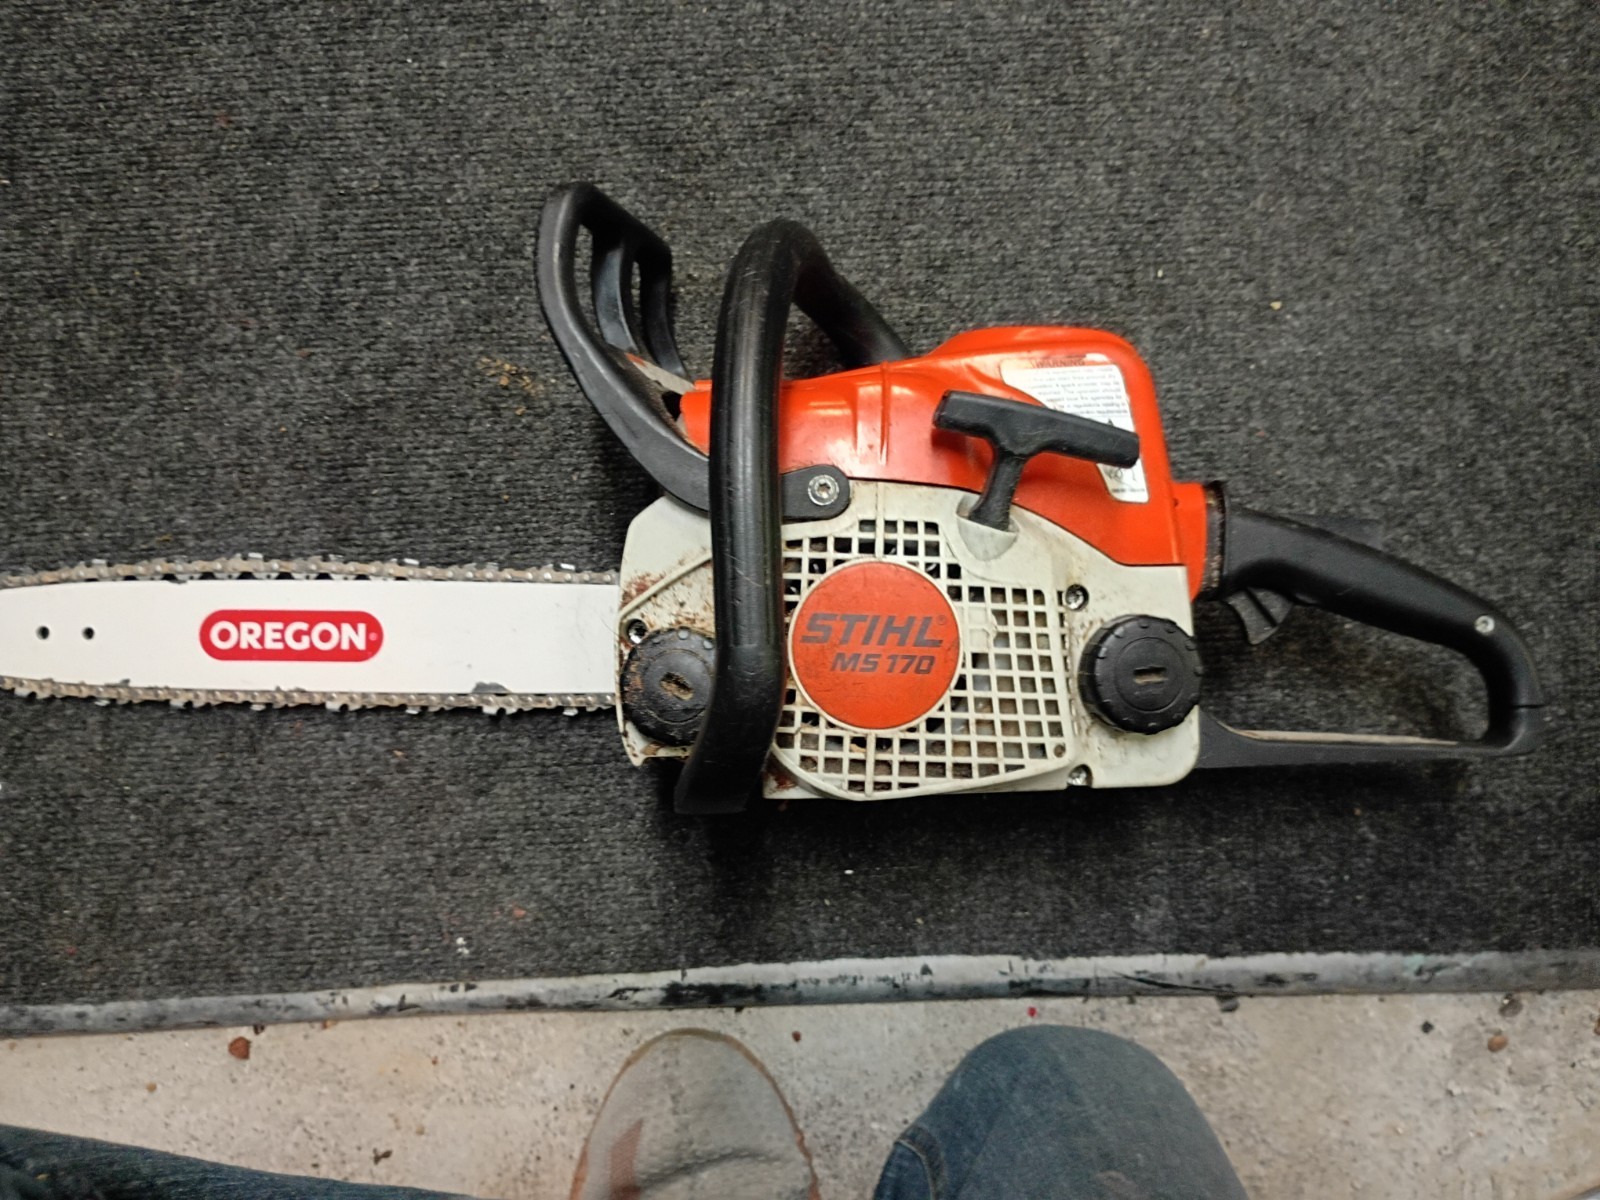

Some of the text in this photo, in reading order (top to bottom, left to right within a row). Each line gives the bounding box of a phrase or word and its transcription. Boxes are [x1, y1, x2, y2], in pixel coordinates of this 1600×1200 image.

[209, 620, 367, 651] OREGON
[801, 613, 944, 648] STIHL
[830, 652, 935, 675] MS 170
